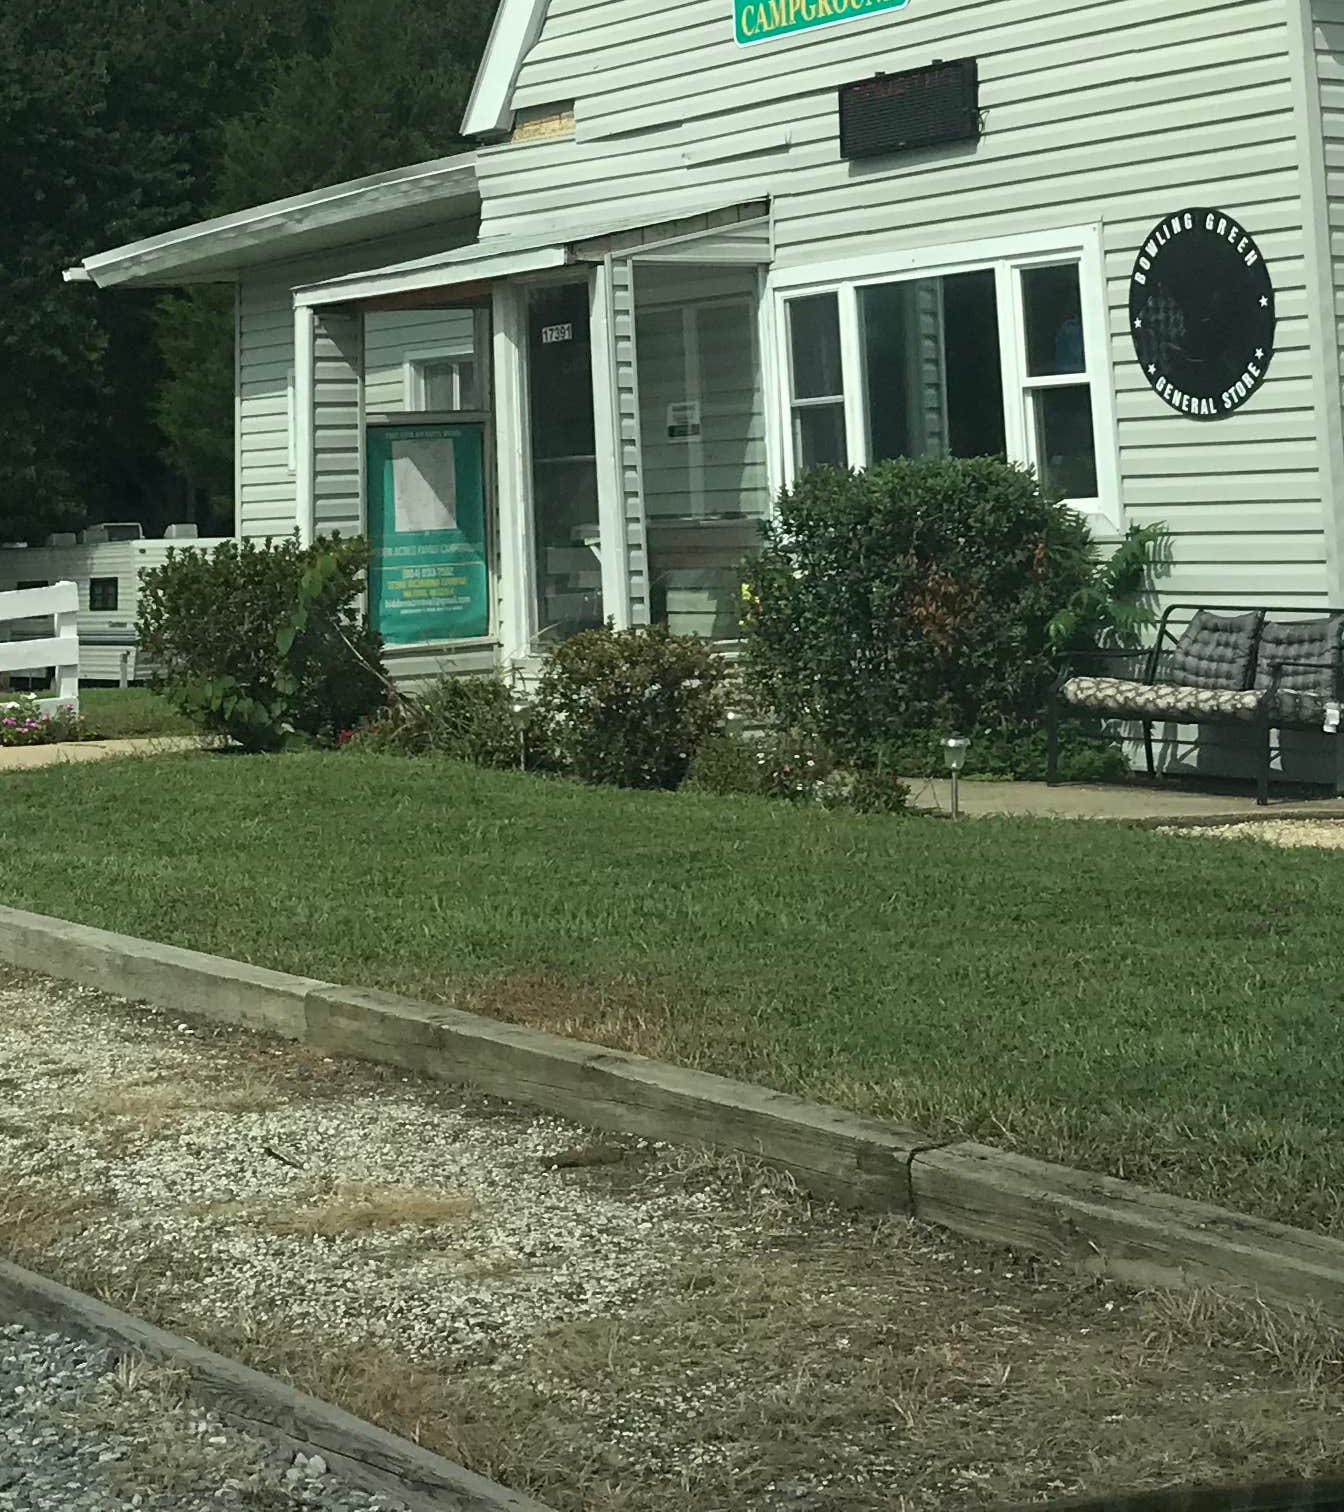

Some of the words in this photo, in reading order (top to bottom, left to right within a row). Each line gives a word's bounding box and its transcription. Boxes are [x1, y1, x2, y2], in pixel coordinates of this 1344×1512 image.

[1134, 213, 1193, 285] BOWLING
[1205, 213, 1258, 267] GREEN
[543, 324, 572, 342] 17391
[1156, 376, 1217, 415] GENERAL
[1222, 362, 1261, 409] STORE
